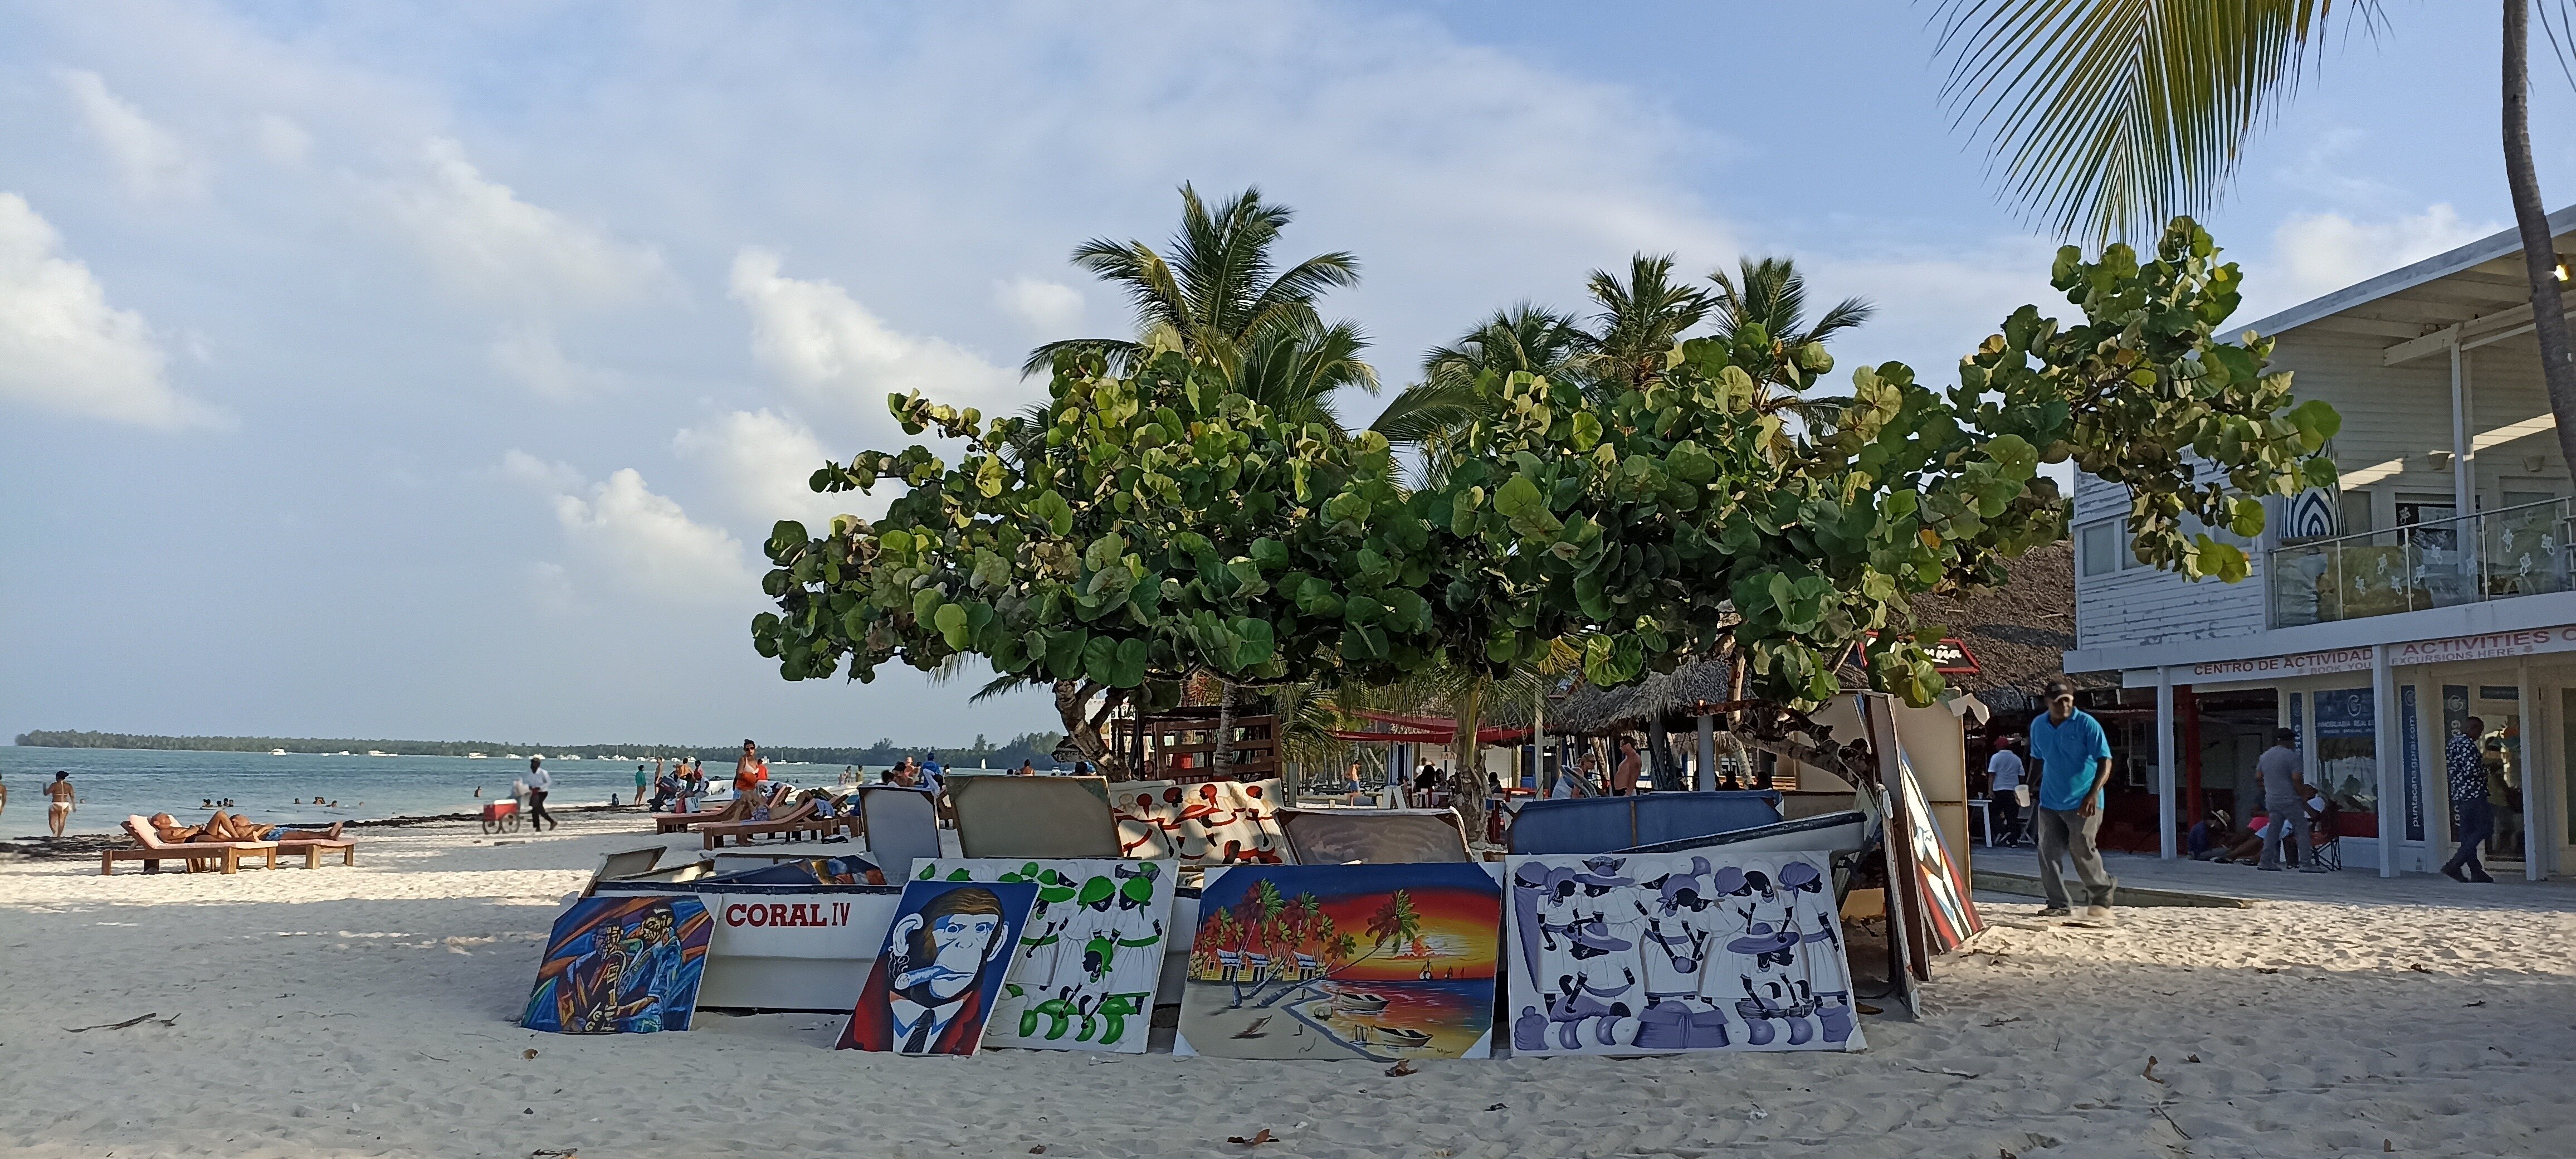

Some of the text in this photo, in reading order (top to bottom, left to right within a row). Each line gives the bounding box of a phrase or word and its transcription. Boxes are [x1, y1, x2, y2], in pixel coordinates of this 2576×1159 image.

[2194, 661, 2253, 676] CENTRO
[2258, 659, 2279, 670] DE
[2284, 648, 2373, 669] ACTIVIDAD
[2403, 630, 2550, 656] ACTIVITIES
[2310, 648, 2515, 675] BOOK YOU EXCURSIONS HERE
[725, 902, 851, 927] CORAL IV
